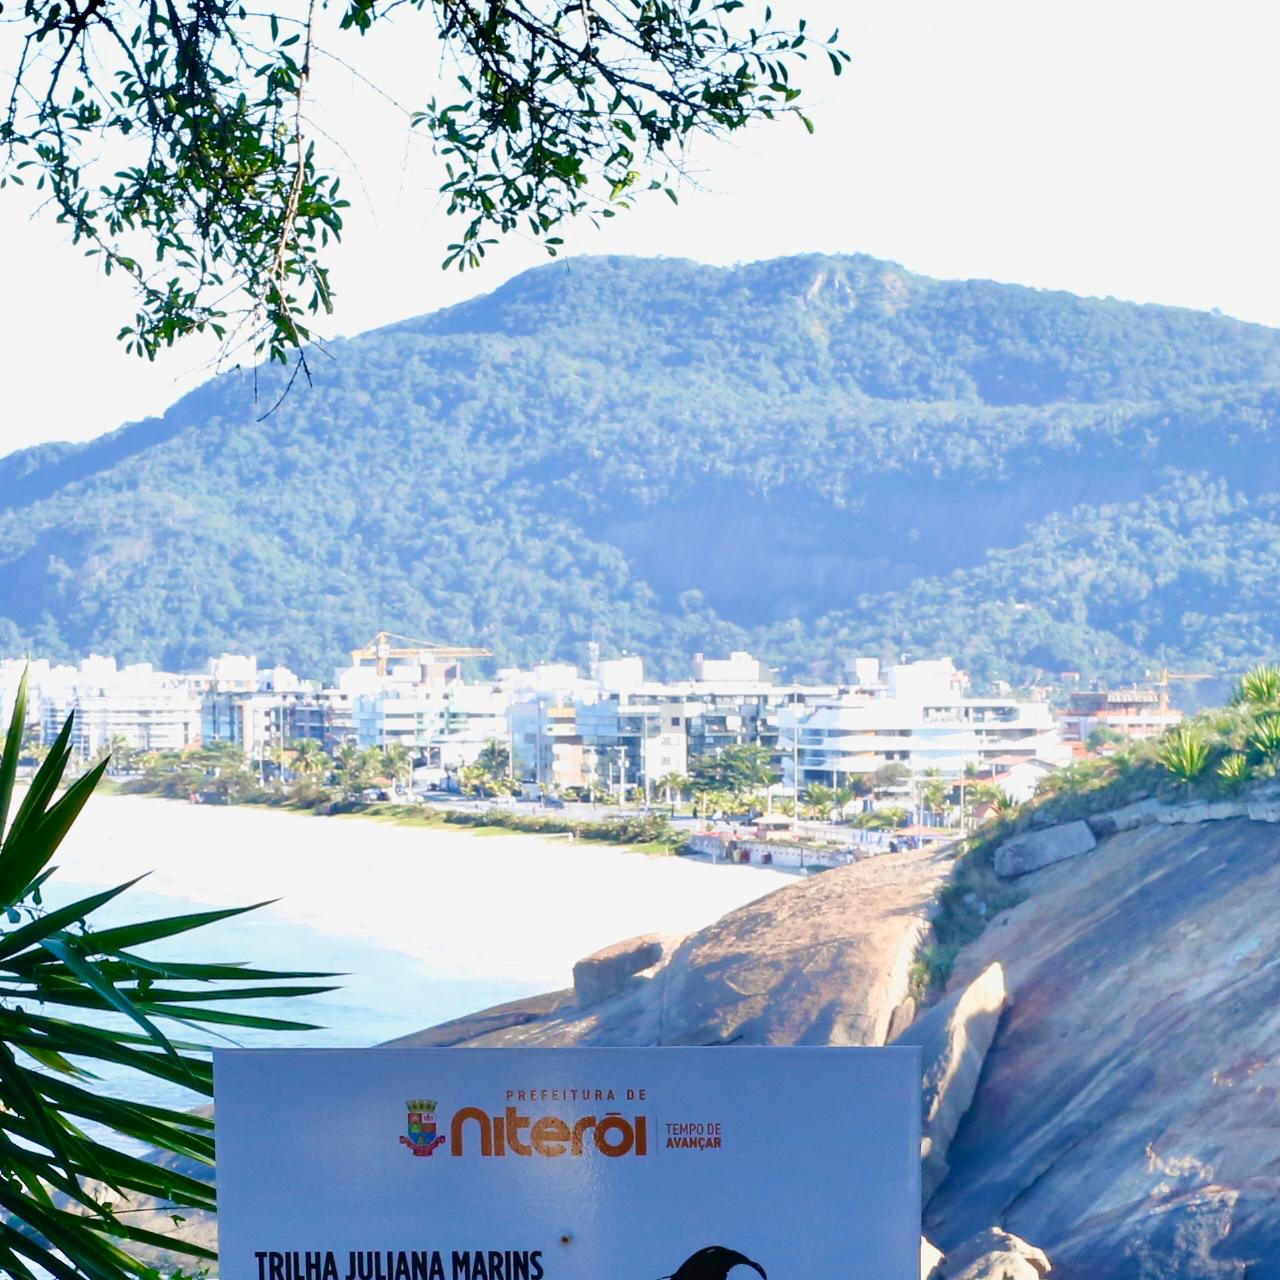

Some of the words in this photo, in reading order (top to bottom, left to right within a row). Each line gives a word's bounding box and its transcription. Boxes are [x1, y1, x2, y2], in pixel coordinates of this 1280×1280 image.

[506, 1089, 616, 1101] PREFEITURA
[626, 1089, 646, 1100] DE
[665, 1123, 705, 1136] TEMPO
[707, 1123, 721, 1136] DE
[665, 1136, 721, 1151] AVANÇAR
[451, 1250, 544, 1280] MARINS
